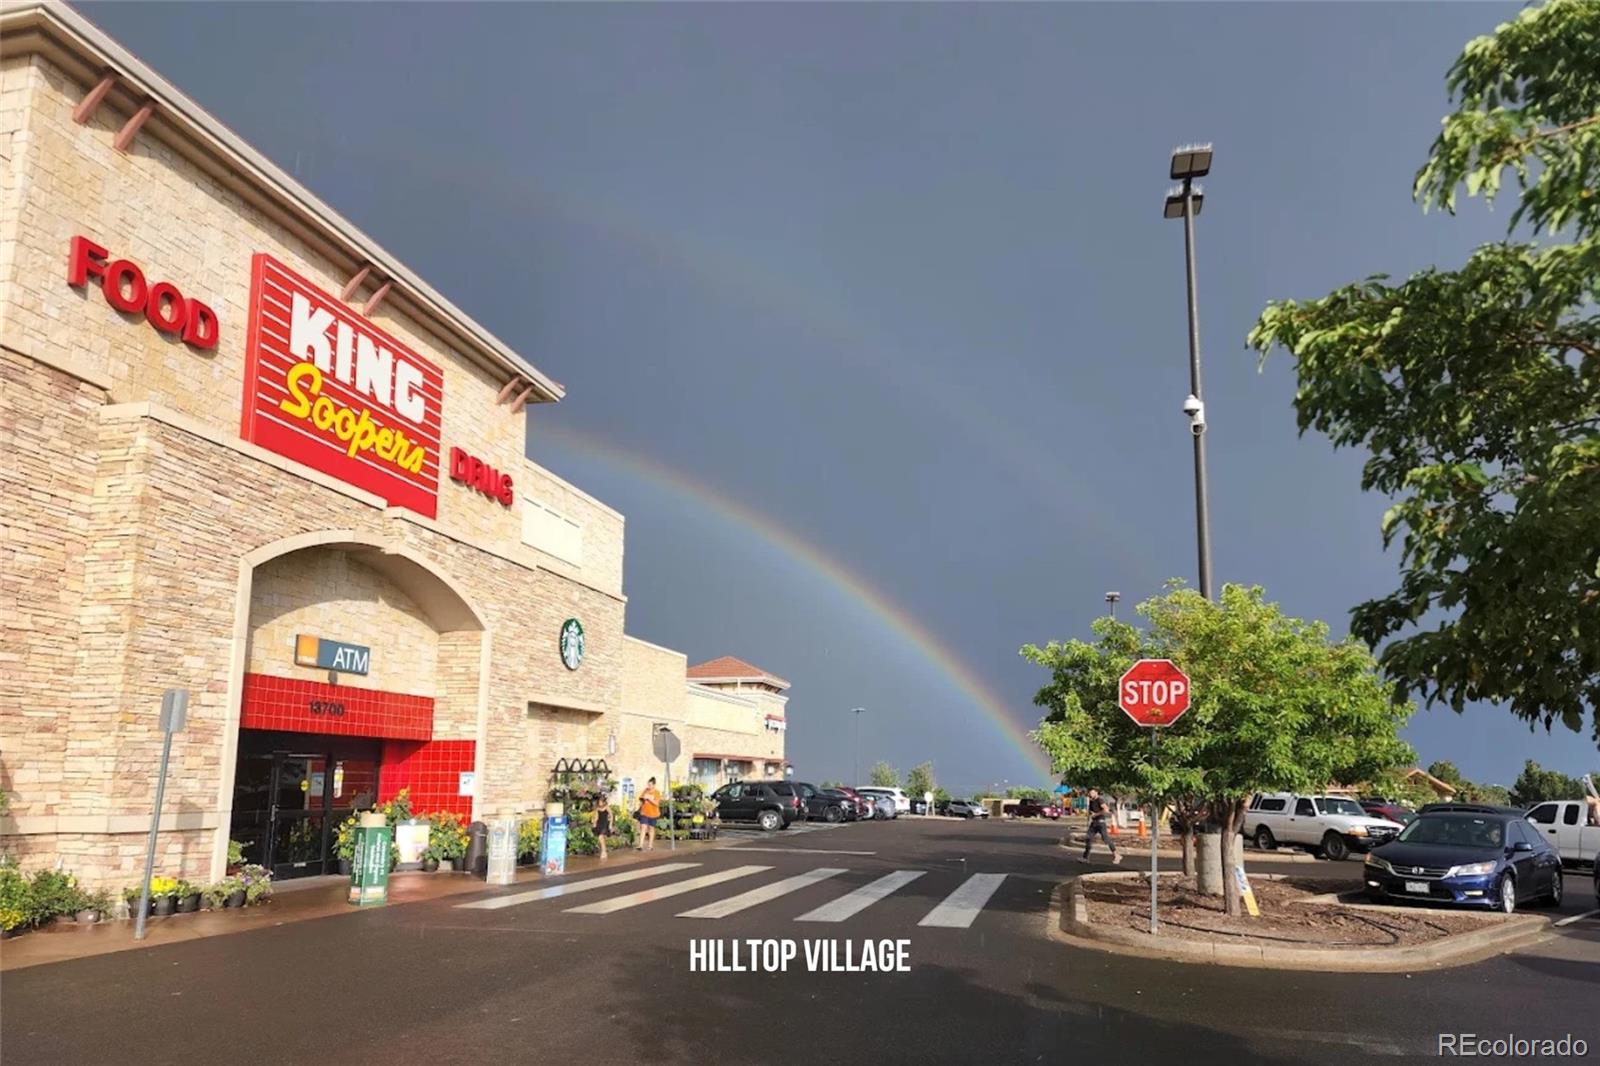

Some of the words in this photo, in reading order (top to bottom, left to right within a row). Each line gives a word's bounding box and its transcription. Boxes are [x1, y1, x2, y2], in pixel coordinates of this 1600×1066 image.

[68, 235, 219, 349] FOOD
[289, 290, 425, 424] KING
[279, 362, 425, 474] Soopers
[450, 446, 513, 506] DRUG
[332, 646, 369, 672] ATM
[310, 700, 345, 717] 13700
[1124, 680, 1185, 705] STOP
